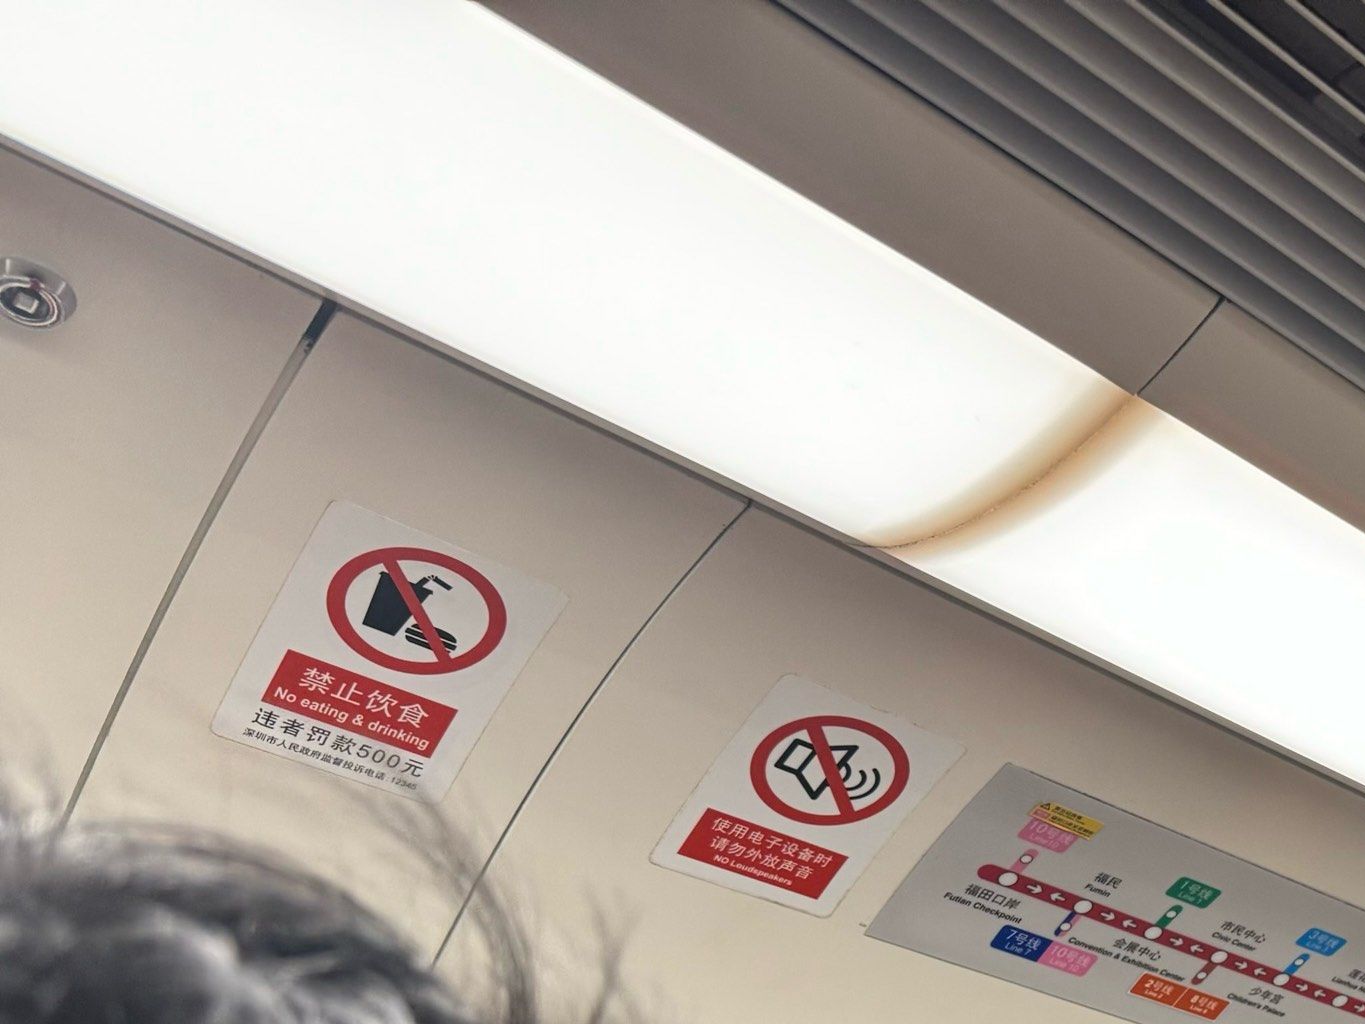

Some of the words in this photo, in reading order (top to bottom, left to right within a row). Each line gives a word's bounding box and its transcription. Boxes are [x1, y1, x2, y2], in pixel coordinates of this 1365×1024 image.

[299, 667, 429, 728] 禁止饮食
[274, 686, 297, 703] No
[301, 697, 349, 724] eating
[352, 714, 364, 727] &
[368, 718, 429, 751] drinking
[251, 708, 424, 778] 违者罚款500元
[710, 836, 813, 880] 请勿外放声音
[711, 817, 833, 868] 使用电子设备时
[713, 854, 730, 865] NO
[730, 860, 793, 886] Loudspeakers
[1094, 871, 1123, 890] 福民
[964, 883, 1021, 910] 福田口岸
[1084, 883, 1111, 898] Fumin
[943, 892, 972, 908] Futian
[973, 900, 1023, 924] Checkpoint
[1005, 942, 1024, 953] Line
[1006, 929, 1042, 951] 7号线
[1051, 946, 1092, 967] 10号线
[1211, 932, 1231, 944] Civic
[1231, 938, 1256, 952] Center
[1220, 921, 1267, 944] 市民中心
[1068, 937, 1113, 957] Convention
[1160, 969, 1186, 982] Center
[1112, 938, 1161, 961] 会展中心
